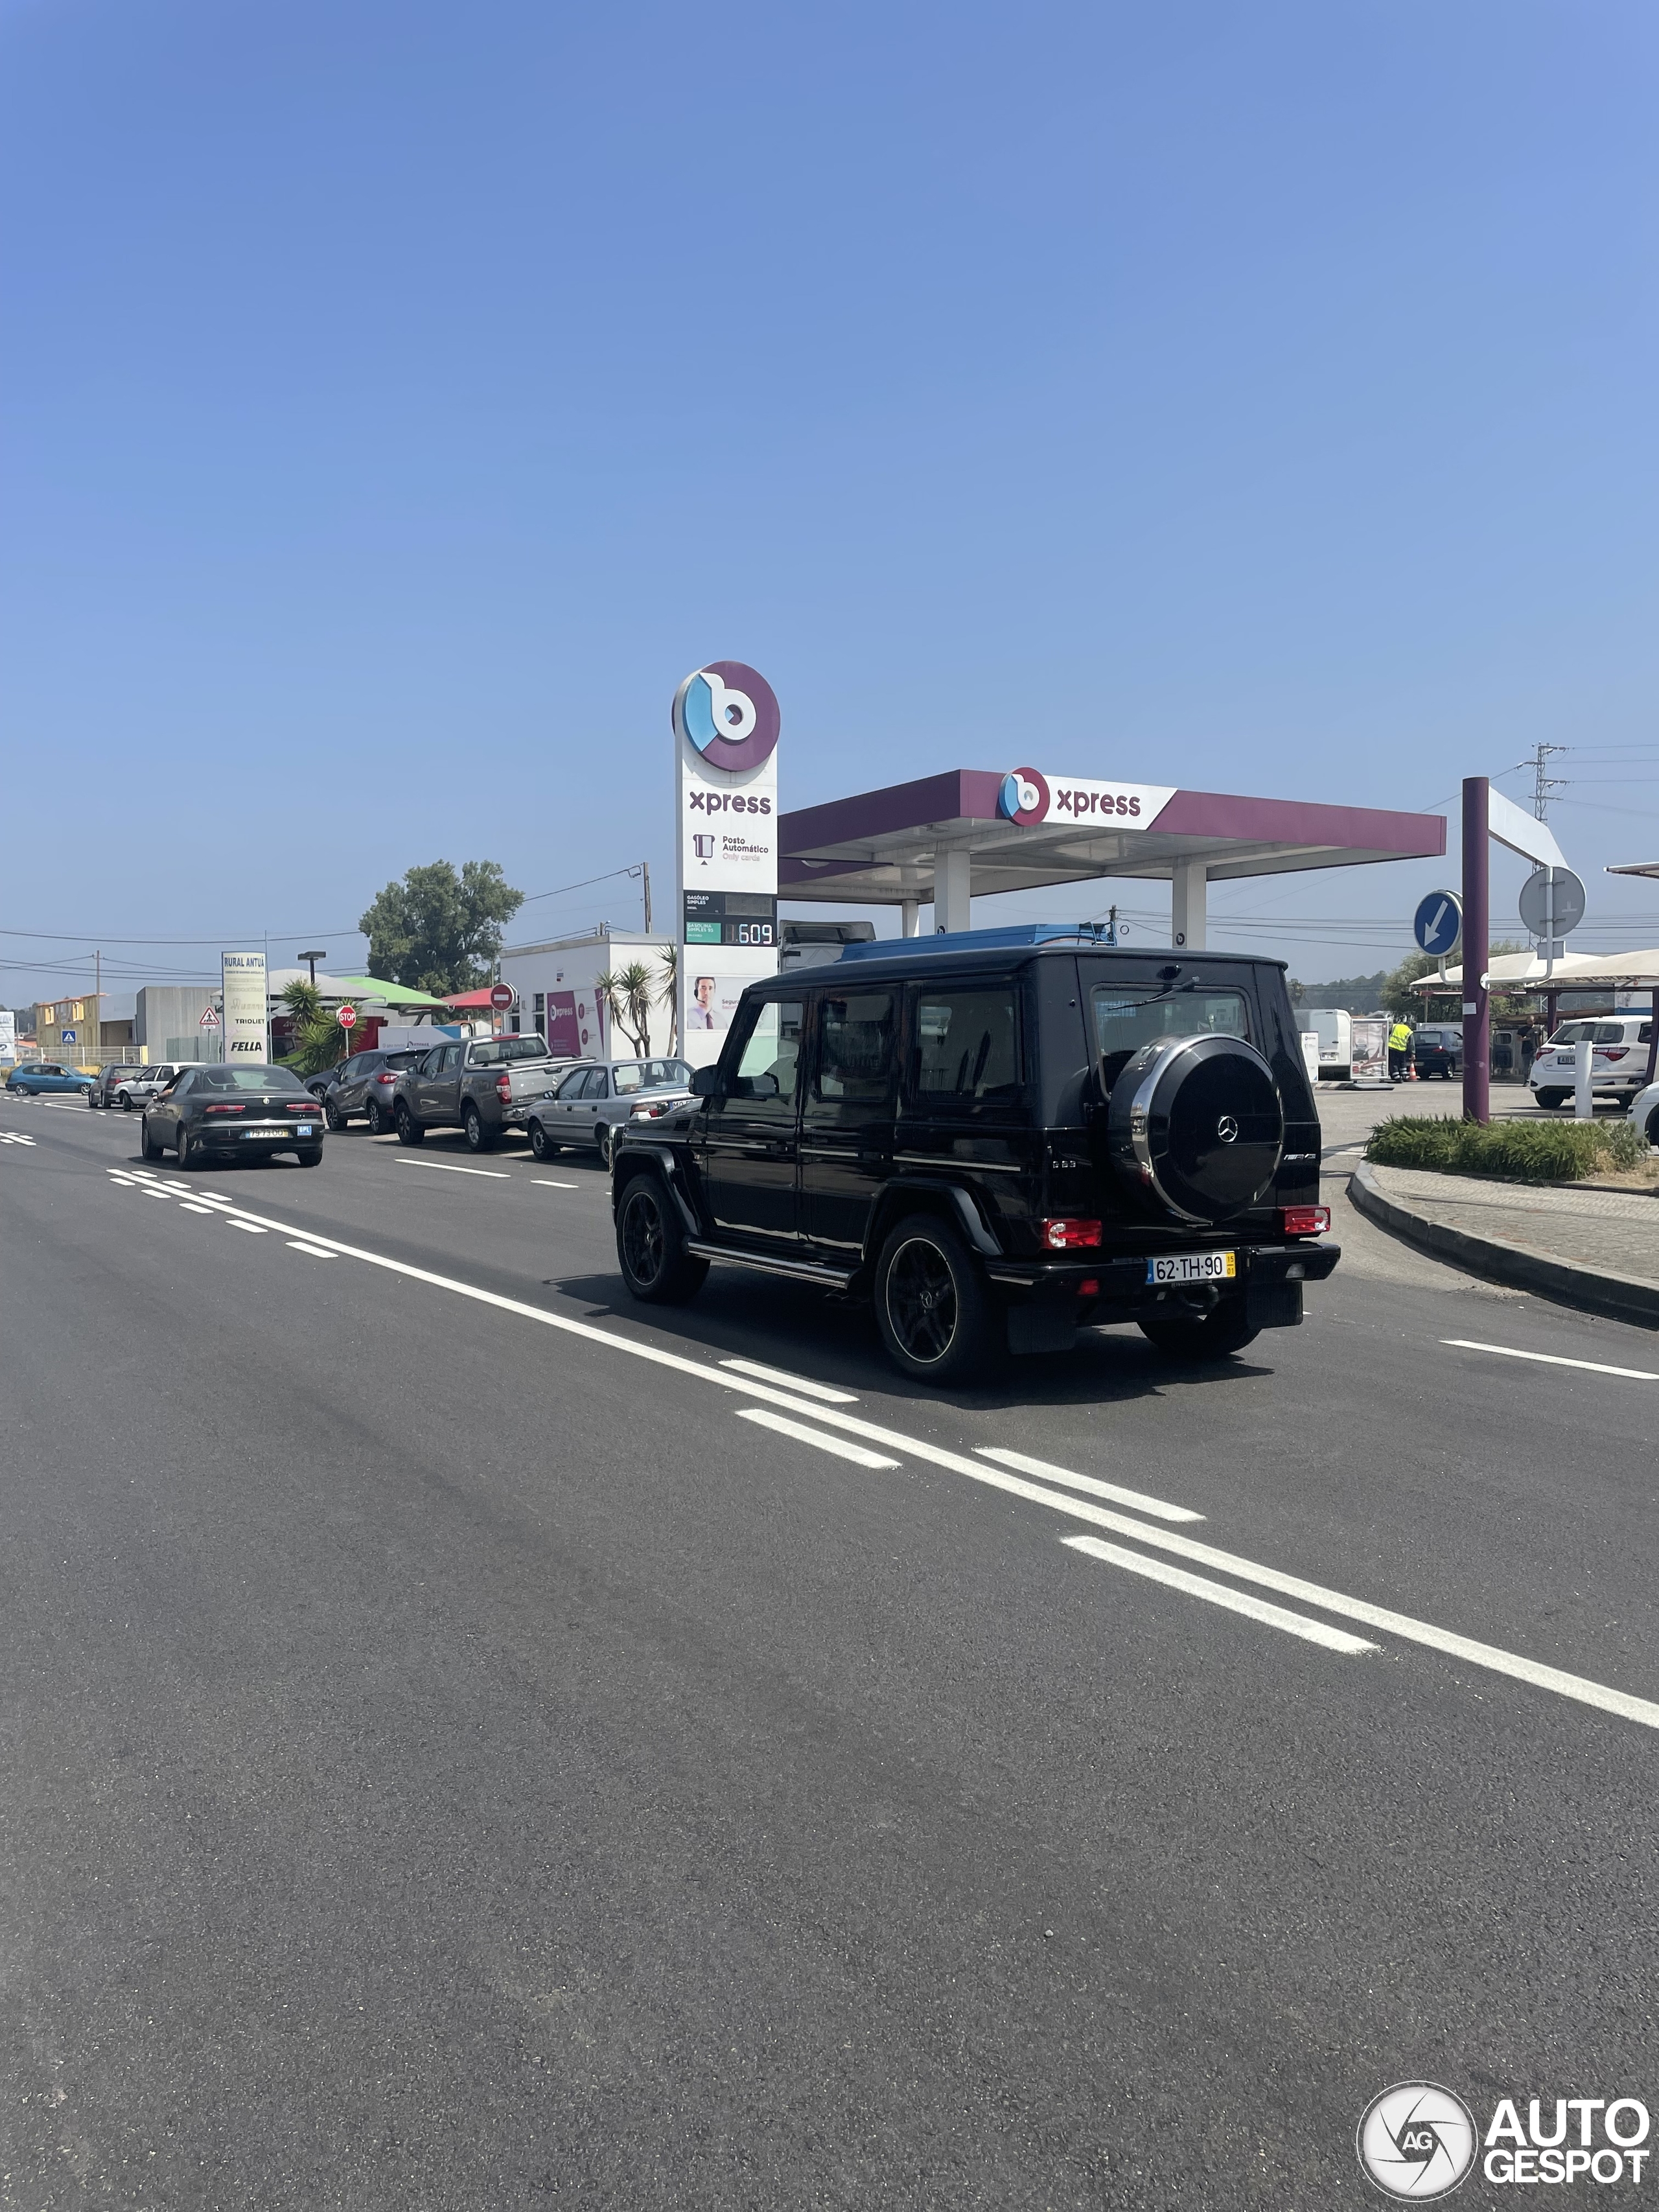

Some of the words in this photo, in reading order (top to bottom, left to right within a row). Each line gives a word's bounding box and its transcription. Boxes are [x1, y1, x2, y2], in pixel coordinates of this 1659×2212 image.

[690, 791, 771, 815] xpress
[1057, 789, 1141, 818] xpress
[723, 836, 745, 844] Posto
[723, 844, 769, 854] Automático
[723, 853, 739, 861] Only
[224, 957, 244, 967] RURAL
[231, 1042, 262, 1051] FELLA
